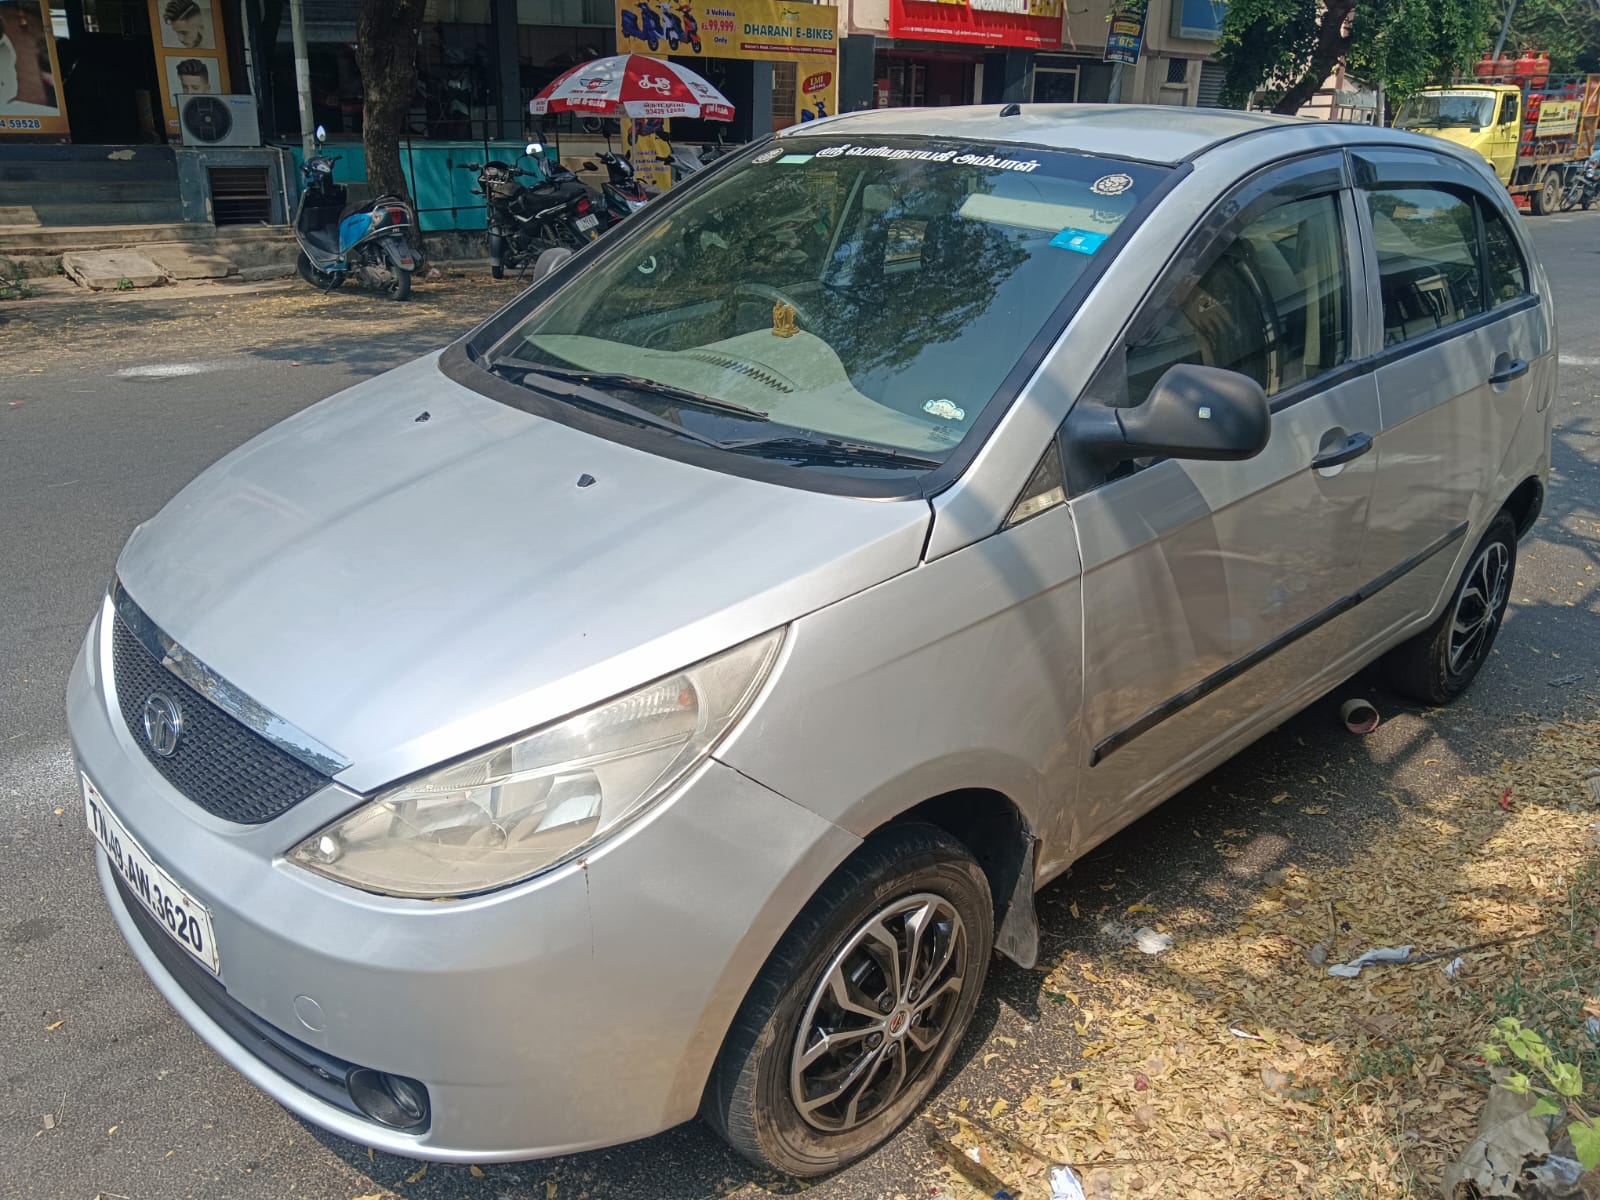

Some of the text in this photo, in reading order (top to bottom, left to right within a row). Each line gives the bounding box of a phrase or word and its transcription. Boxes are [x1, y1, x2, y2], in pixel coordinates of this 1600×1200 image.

[711, 9, 736, 17] Vehicles
[744, 23, 833, 40] DHARANI E-BIKES
[714, 37, 728, 45] Only
[9, 119, 41, 129] 59528
[844, 146, 958, 162] பெரியநாயகி
[952, 154, 1041, 172] அம்பாள்
